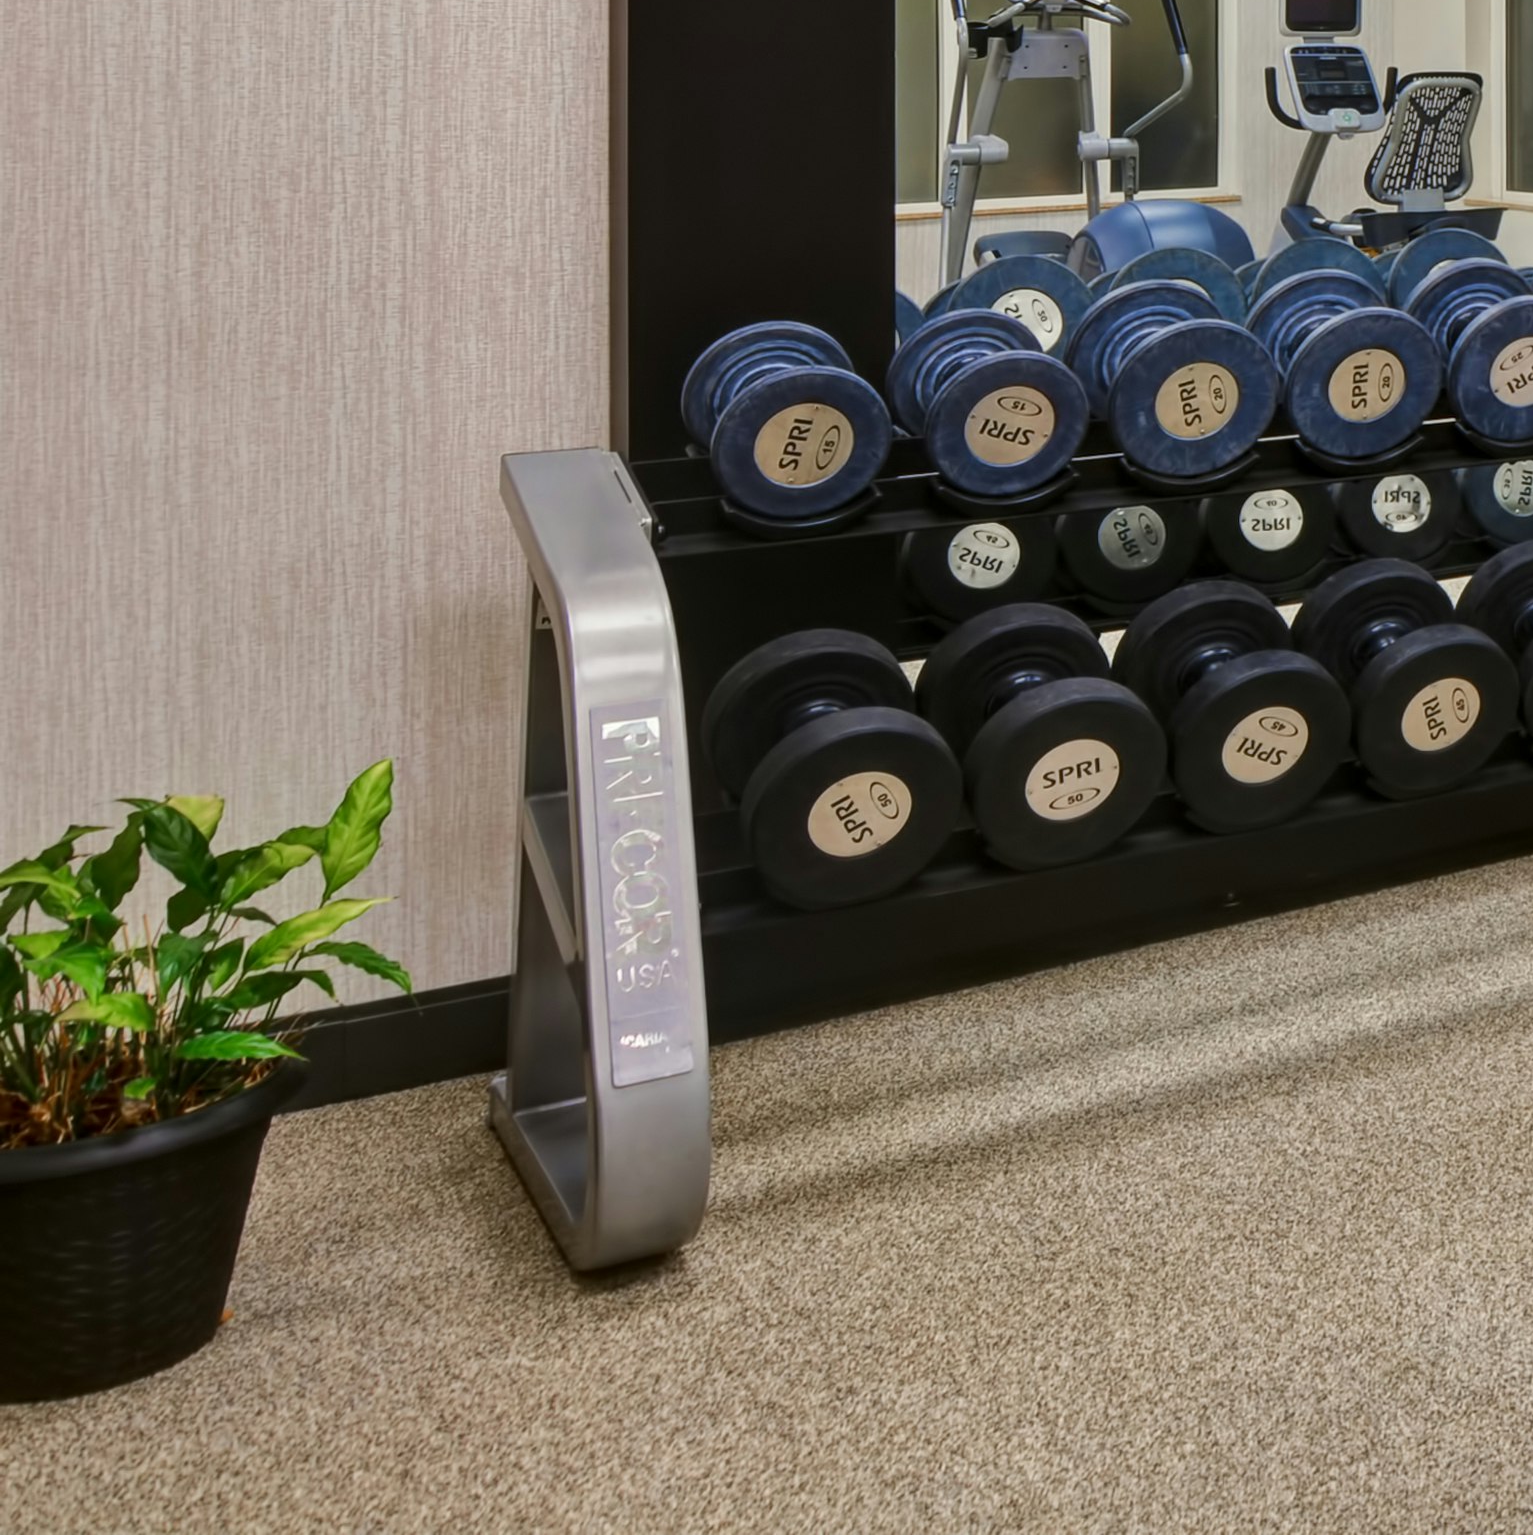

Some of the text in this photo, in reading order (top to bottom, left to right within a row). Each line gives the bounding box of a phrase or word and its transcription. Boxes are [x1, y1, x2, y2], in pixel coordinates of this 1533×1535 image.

[1511, 351, 1525, 364] 25
[1213, 387, 1224, 402] 20
[1350, 363, 1370, 410] SPRI
[1381, 376, 1391, 390] 20
[1012, 400, 1027, 412] 15
[1178, 379, 1203, 427] SPRI
[778, 418, 814, 471] SPRI
[978, 418, 1035, 448] SPRI
[821, 439, 836, 456] 15
[1269, 720, 1287, 732] 45
[1421, 694, 1447, 741] SPRI
[1235, 736, 1288, 766] SPRI
[1041, 757, 1101, 789] SPRI
[876, 792, 893, 808] 50
[1066, 792, 1084, 806] 50
[830, 794, 874, 846] SPRI
